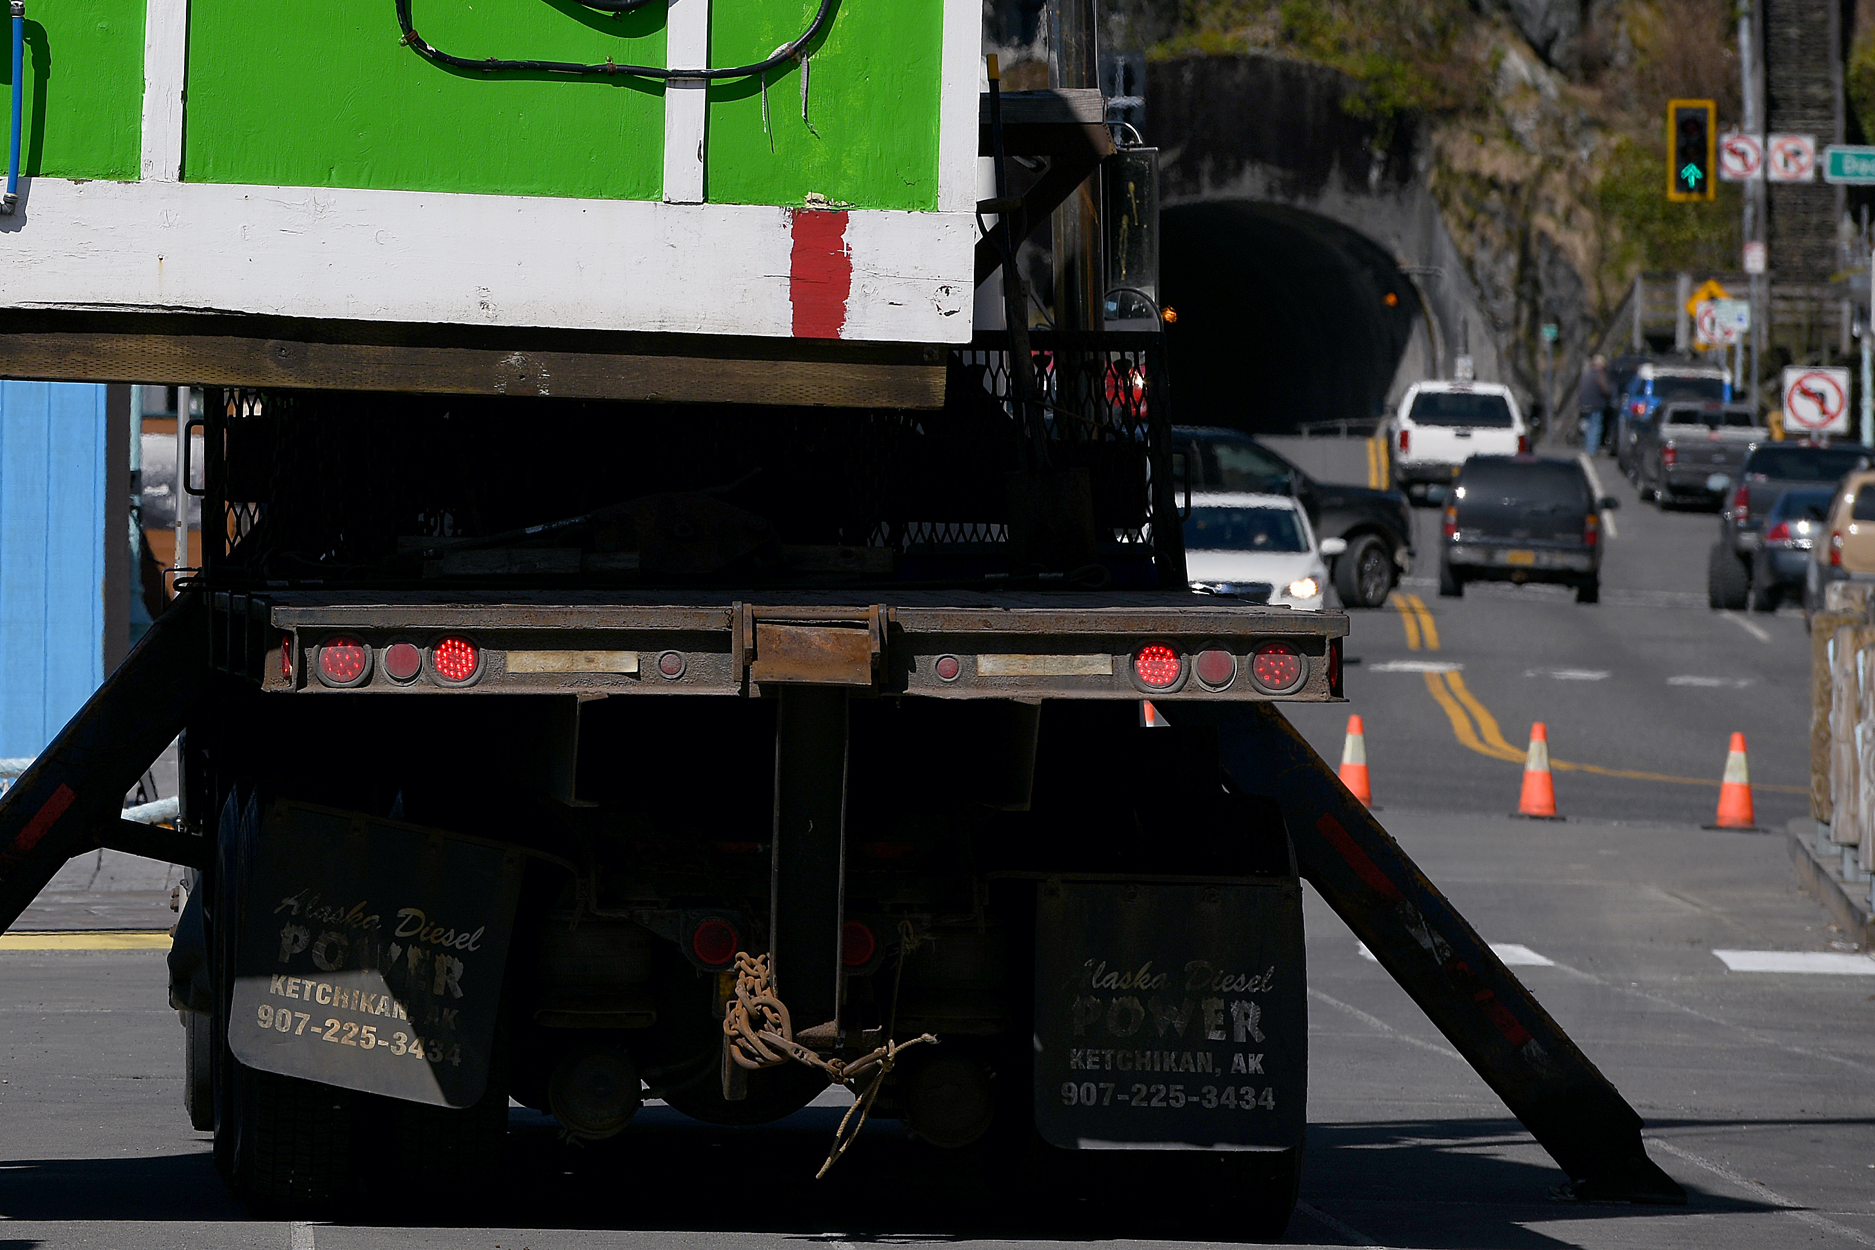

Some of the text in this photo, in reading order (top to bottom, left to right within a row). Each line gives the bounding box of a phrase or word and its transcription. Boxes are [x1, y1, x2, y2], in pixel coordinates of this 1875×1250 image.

[274, 888, 486, 953] Alaska Diesel
[269, 973, 415, 1027] KETCHIKAN,
[1082, 957, 1275, 994] laska Diesel
[256, 1004, 463, 1068] 907-225-3434
[1072, 993, 1267, 1044] POWER
[1069, 1048, 1265, 1078] KETCHIKAN, AK
[1060, 1081, 1276, 1111] 907-225-3434
